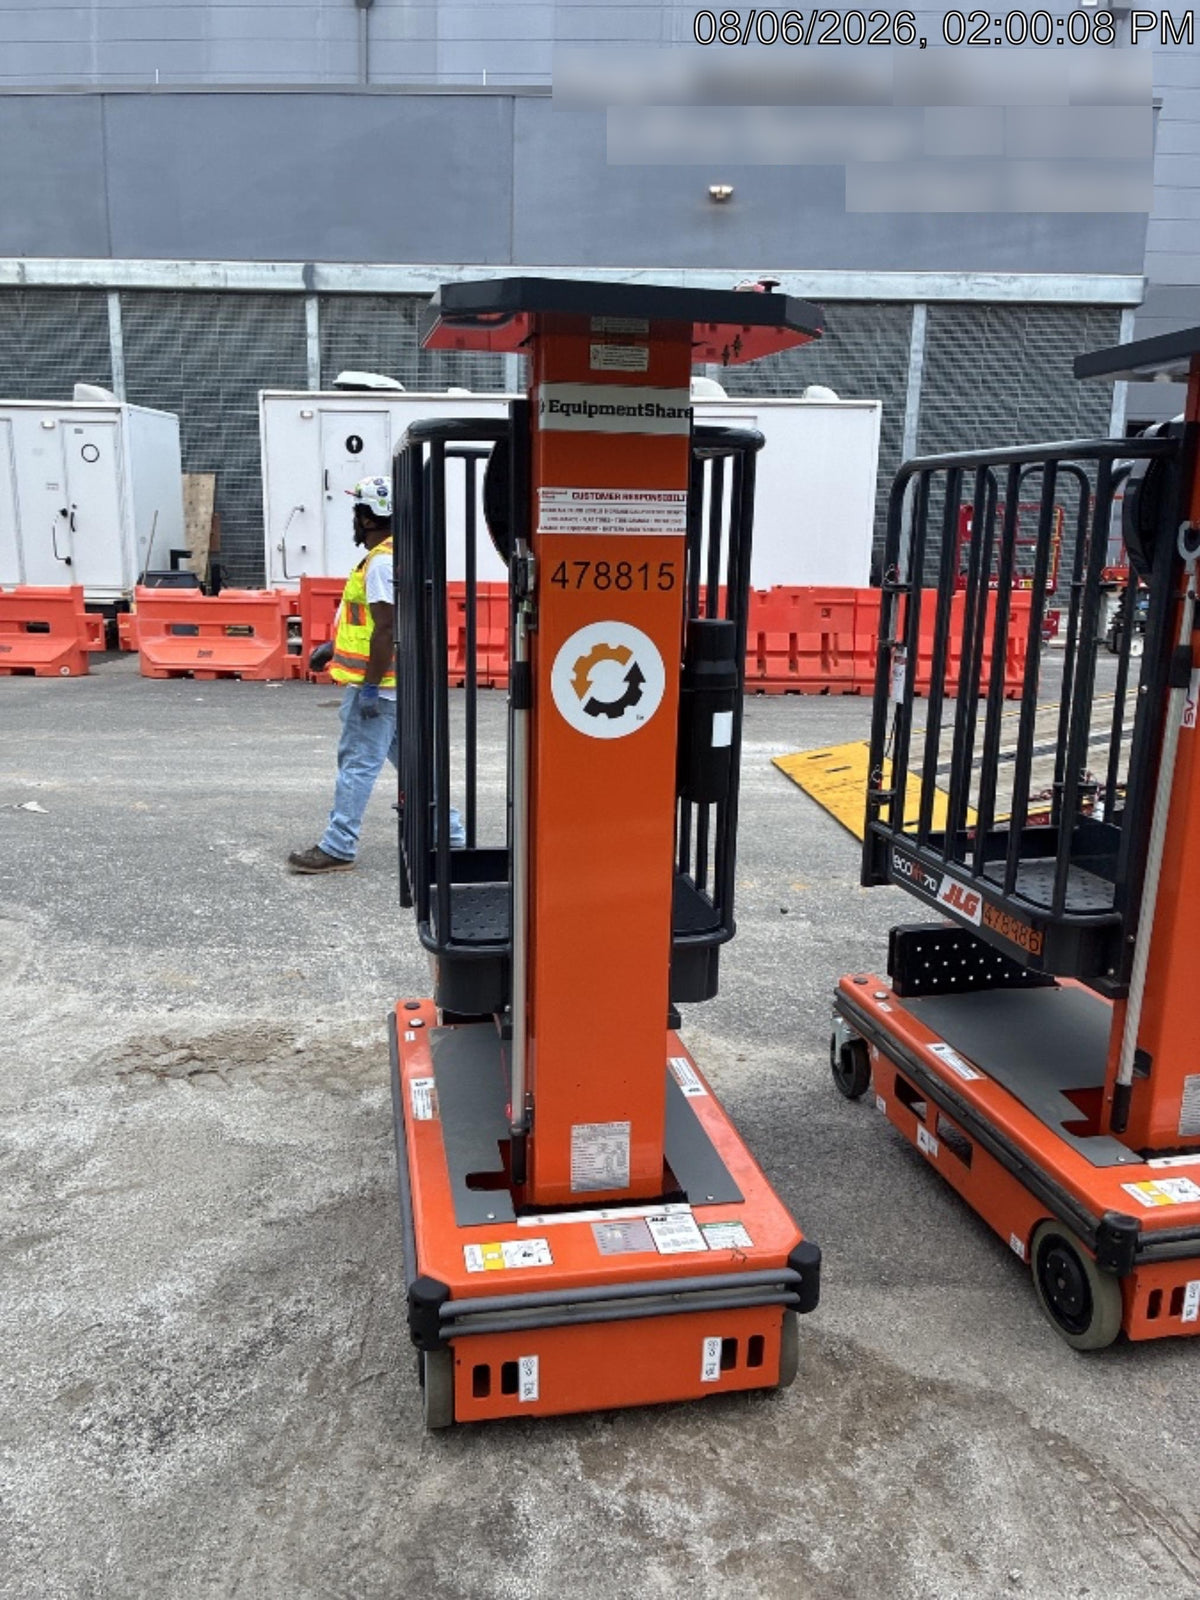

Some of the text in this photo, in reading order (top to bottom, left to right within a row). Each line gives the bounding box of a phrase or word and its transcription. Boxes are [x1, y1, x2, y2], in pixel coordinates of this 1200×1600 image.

[572, 491, 621, 501] CUSTOMER
[550, 561, 675, 591] 478815
[942, 883, 980, 918] JLG
